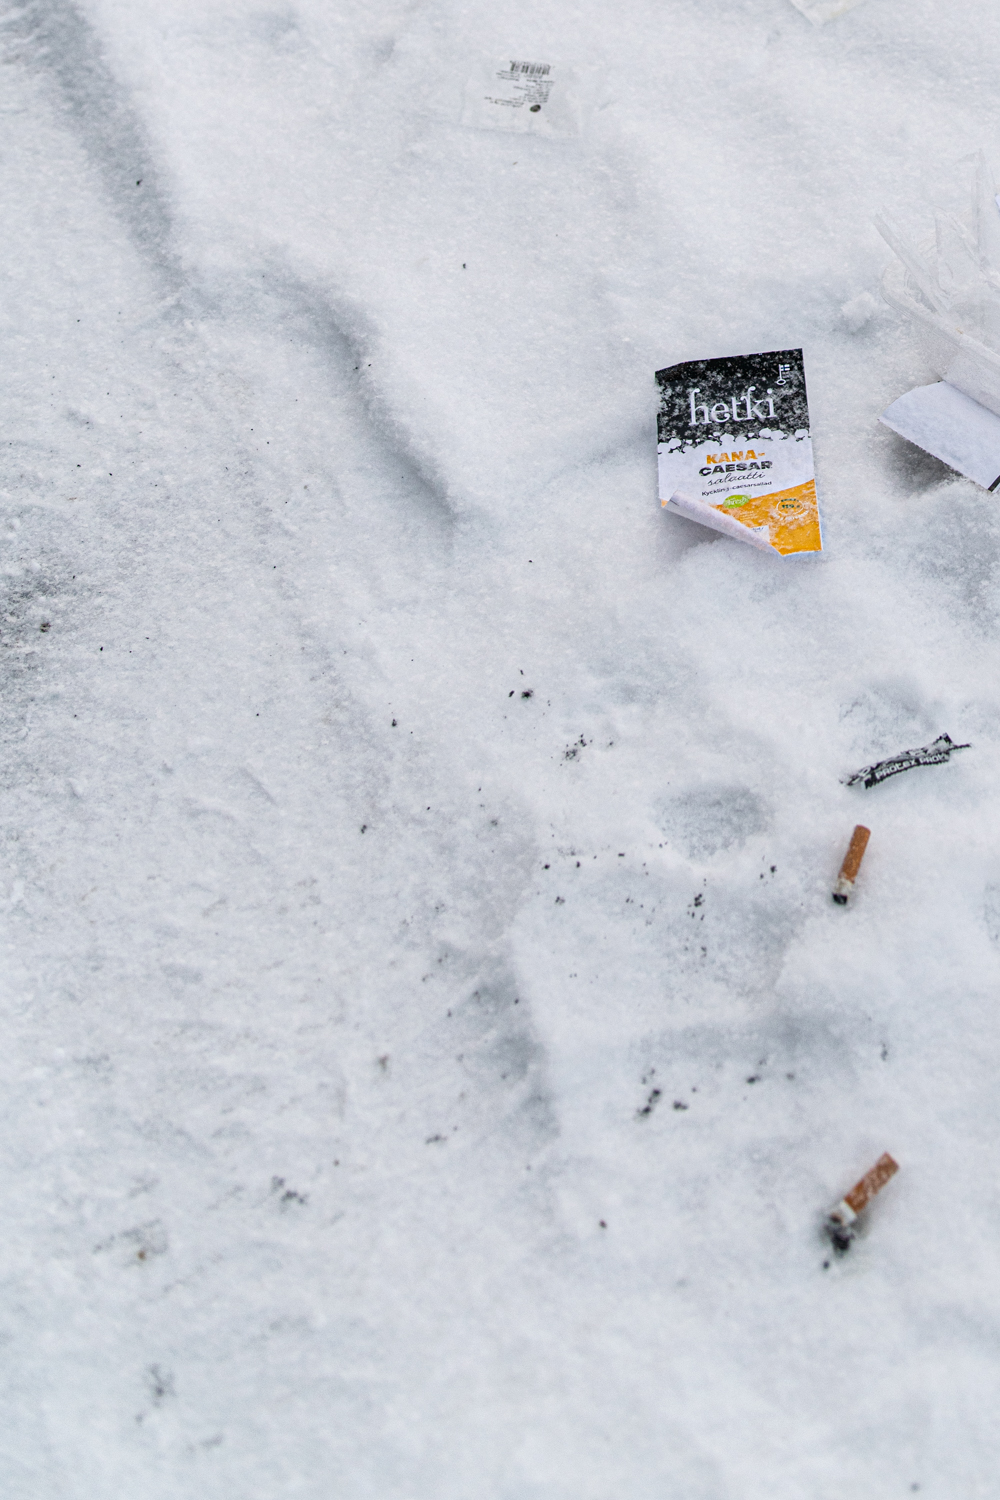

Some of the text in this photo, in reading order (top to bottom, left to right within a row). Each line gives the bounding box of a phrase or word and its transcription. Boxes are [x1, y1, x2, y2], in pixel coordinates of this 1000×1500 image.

[688, 385, 778, 427] hetki
[706, 449, 766, 465] KANA-
[698, 460, 773, 477] CAESAR
